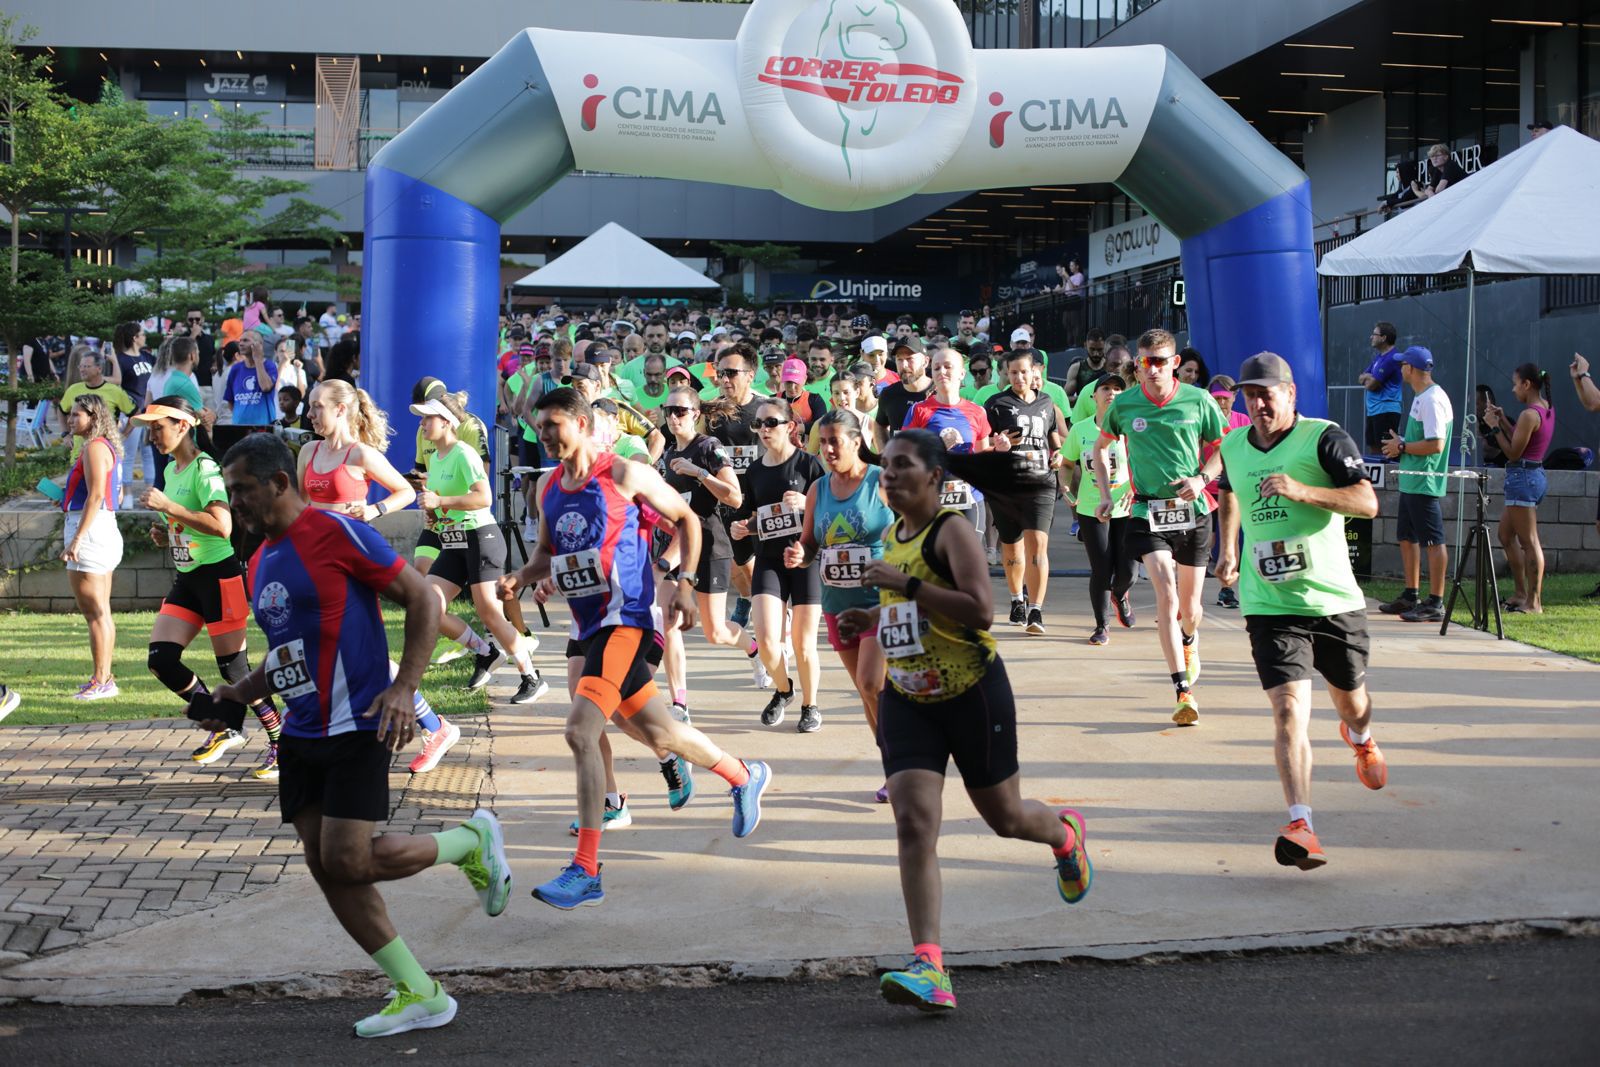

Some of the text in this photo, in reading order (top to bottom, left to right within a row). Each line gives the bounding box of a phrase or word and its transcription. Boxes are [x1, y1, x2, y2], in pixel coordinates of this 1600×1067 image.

[764, 56, 881, 81] CORRER
[204, 73, 250, 94] JAZZ
[848, 82, 960, 104] TOLEDO
[613, 86, 726, 125] CIMA
[1019, 97, 1128, 132] CIMA
[643, 125, 677, 133] INTEGRADO
[839, 280, 922, 301] Uniprime
[939, 493, 962, 505] 747
[765, 515, 792, 531] 895
[1158, 510, 1186, 524] 786
[1251, 509, 1289, 523] CORPA
[442, 531, 464, 543] 919
[173, 548, 189, 560] 505
[829, 564, 862, 580] 915
[1264, 554, 1302, 575] 812
[562, 569, 596, 589] 611
[883, 624, 910, 647] 794
[272, 662, 307, 690] 691
